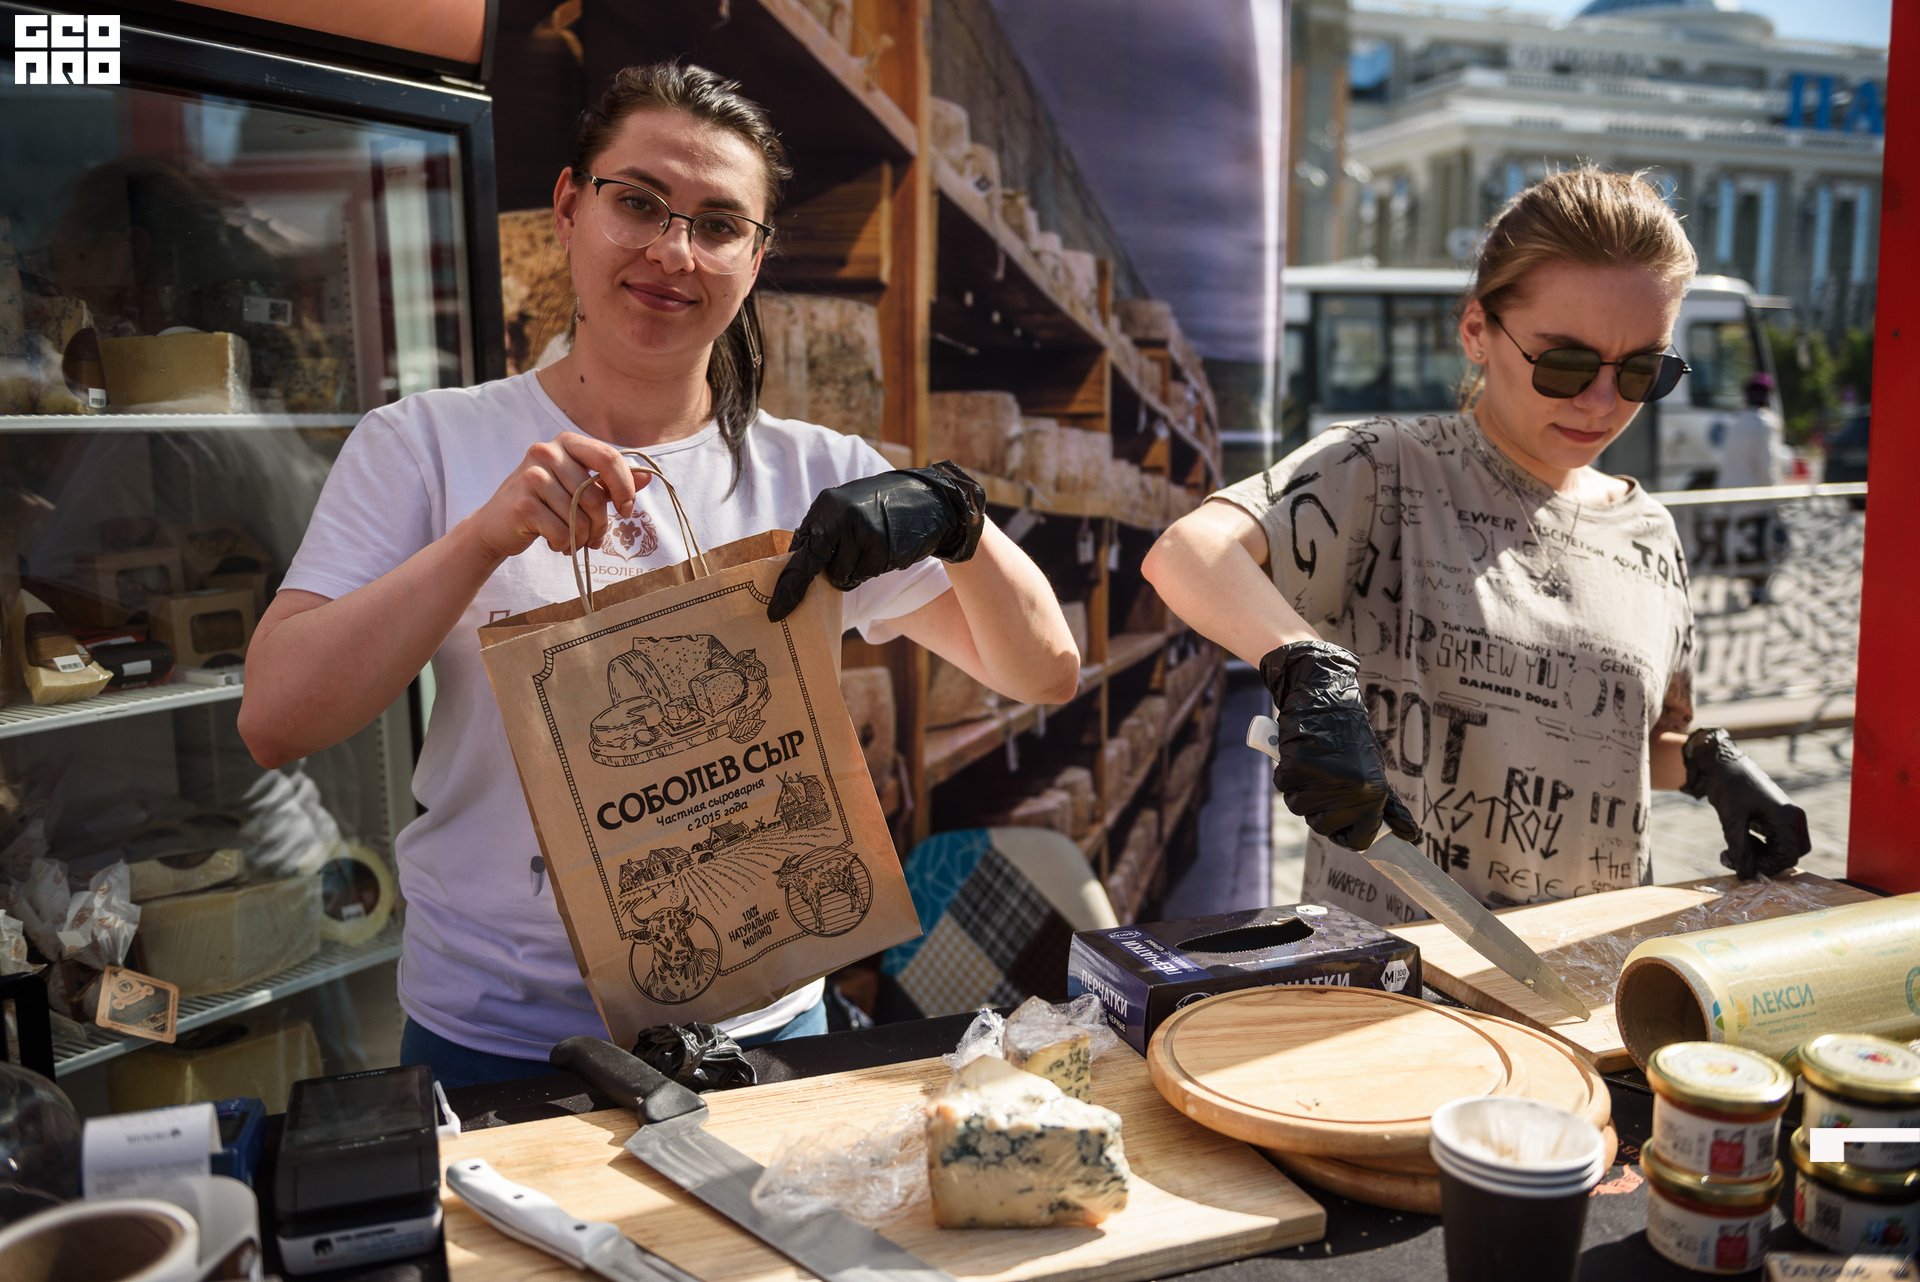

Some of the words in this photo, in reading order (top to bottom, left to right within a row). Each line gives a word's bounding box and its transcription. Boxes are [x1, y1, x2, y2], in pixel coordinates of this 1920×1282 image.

[1459, 677, 1521, 698] DAMNED
[1525, 691, 1558, 709] DOGS
[597, 755, 741, 830] СОБОЛЕВ
[743, 730, 804, 773] СЫР
[656, 800, 707, 826] Частная
[708, 778, 765, 808] сыроварня
[1503, 767, 1574, 813] RIP
[1590, 791, 1626, 828] IT
[687, 820, 694, 831] с
[694, 808, 721, 829] 2015
[724, 801, 749, 817] года
[1327, 868, 1378, 902] WARPED
[728, 908, 780, 942] НАТУРАЛЬНОЕ
[742, 904, 760, 922] 100%
[742, 925, 772, 949] МОЛОКО
[1121, 940, 1183, 976] ПЕРЧАТКИ
[1081, 969, 1128, 1018] ПЕРЧАТКИ
[1752, 983, 1815, 1017] ЛЕКСИ
